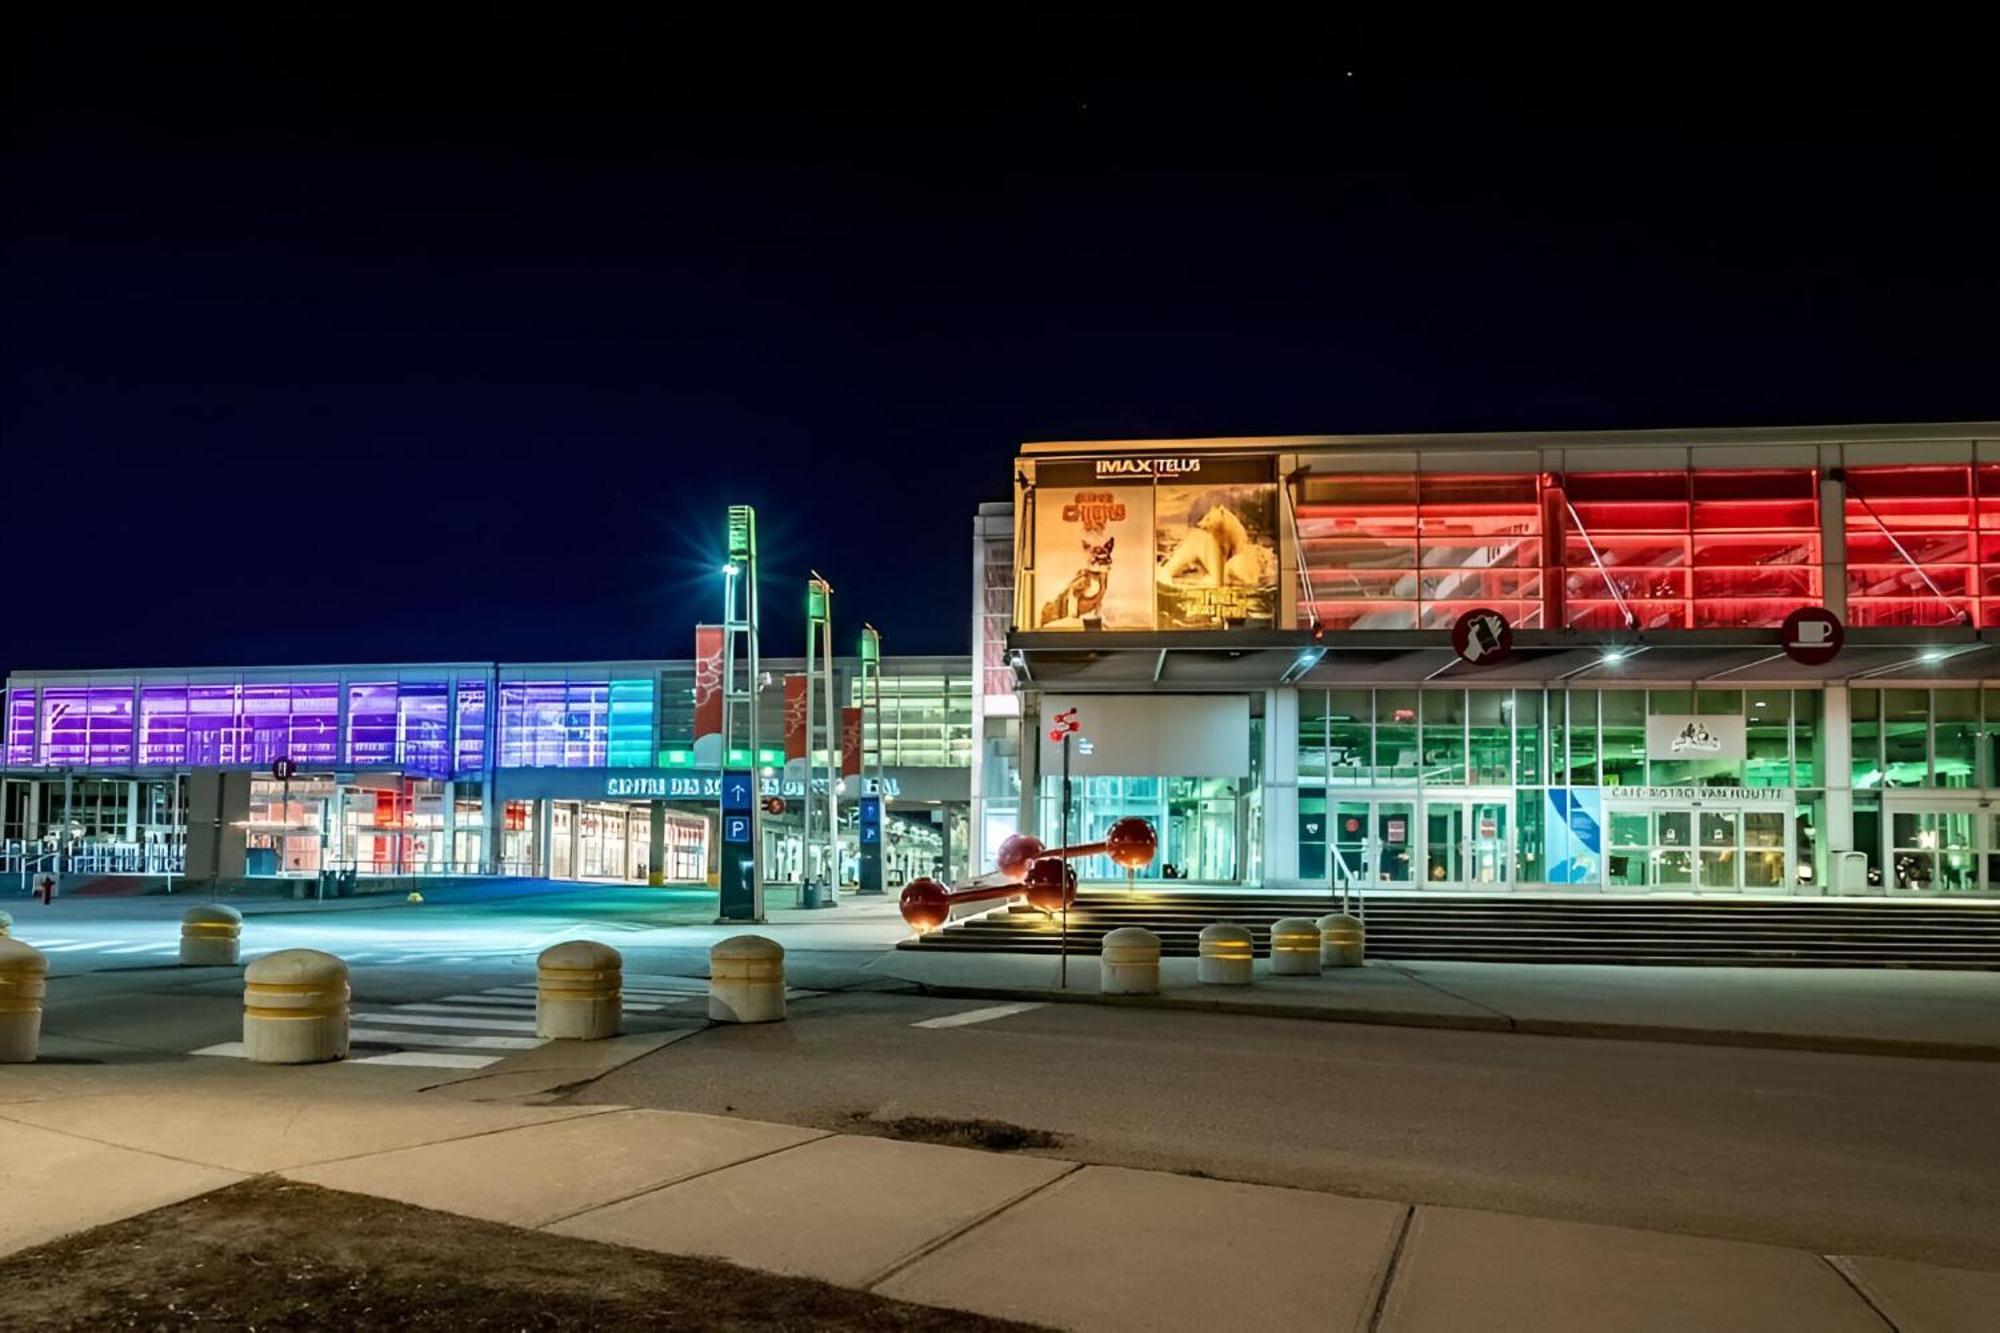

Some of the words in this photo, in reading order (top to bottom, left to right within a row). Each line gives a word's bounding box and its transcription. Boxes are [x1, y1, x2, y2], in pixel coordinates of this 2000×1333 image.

[1096, 460, 1153, 473] IMAX
[1157, 459, 1200, 472] TELUS
[732, 821, 744, 837] P
